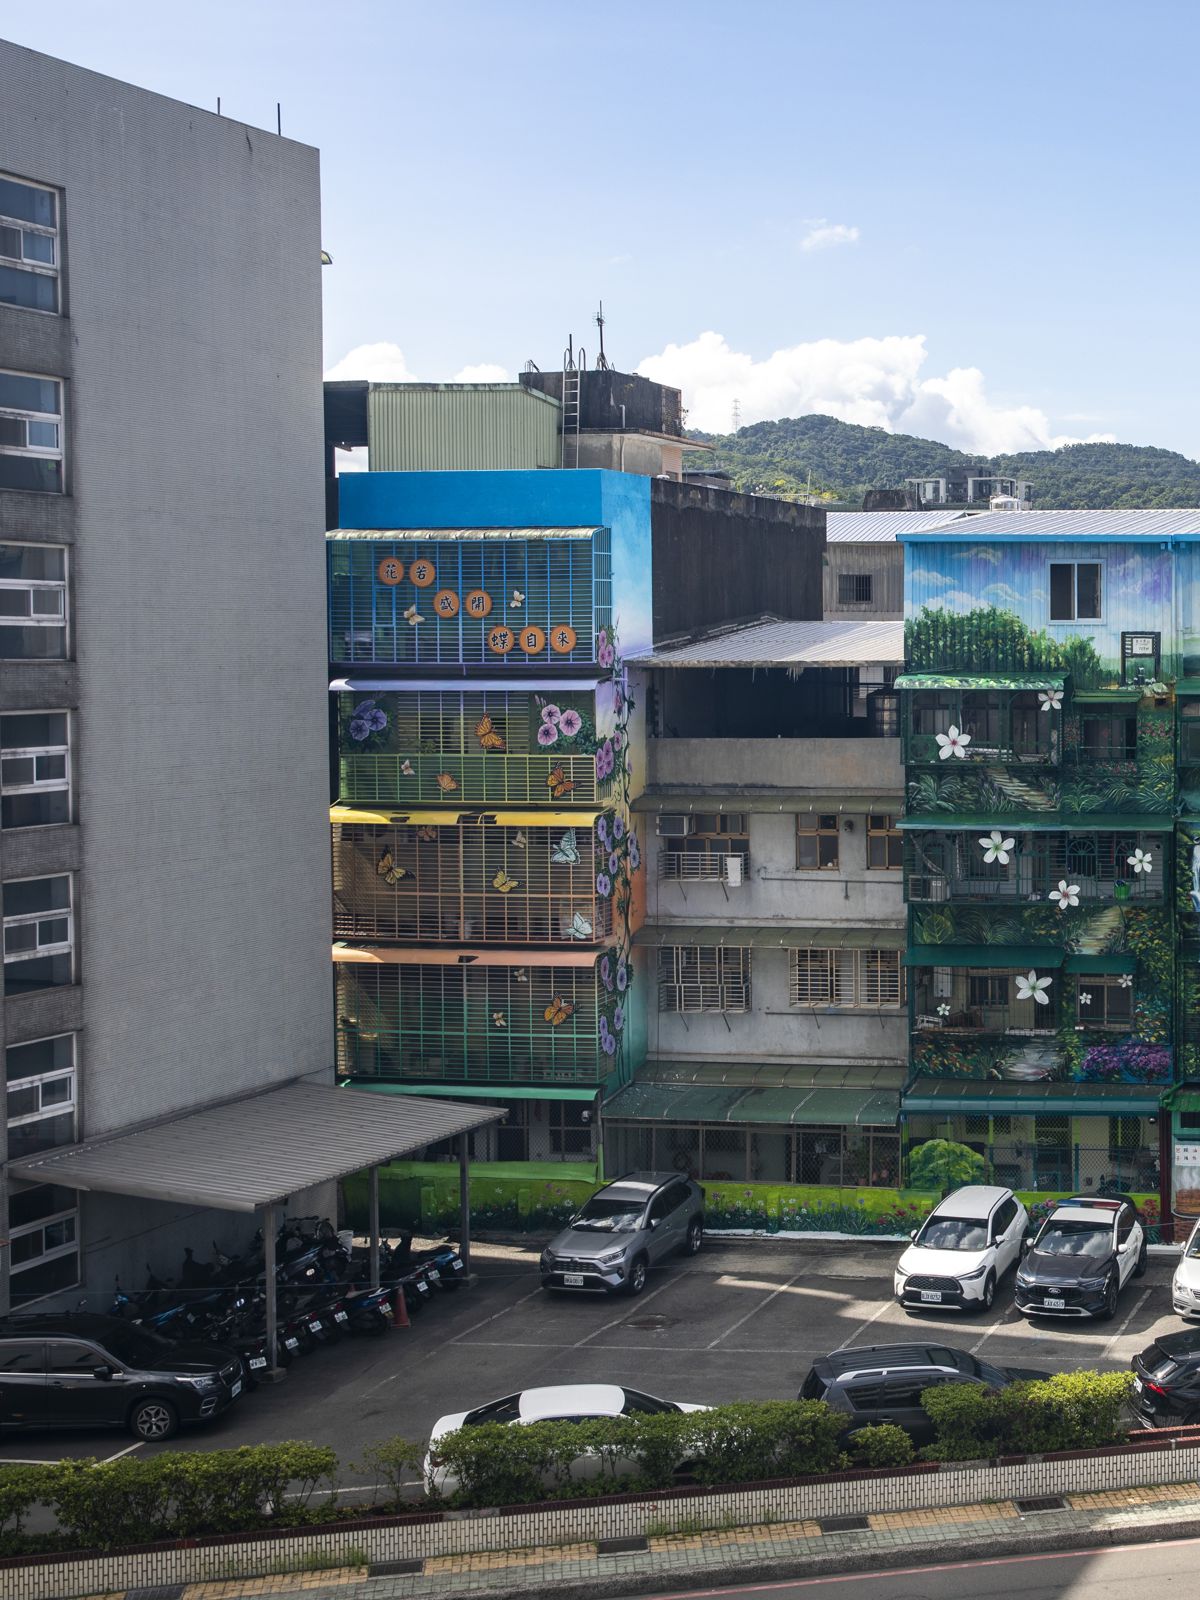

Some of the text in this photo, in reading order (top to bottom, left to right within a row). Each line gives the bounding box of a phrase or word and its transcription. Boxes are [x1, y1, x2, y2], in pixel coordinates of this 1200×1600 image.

[439, 596, 485, 612] 盛開
[491, 631, 570, 650] 蝶自來
